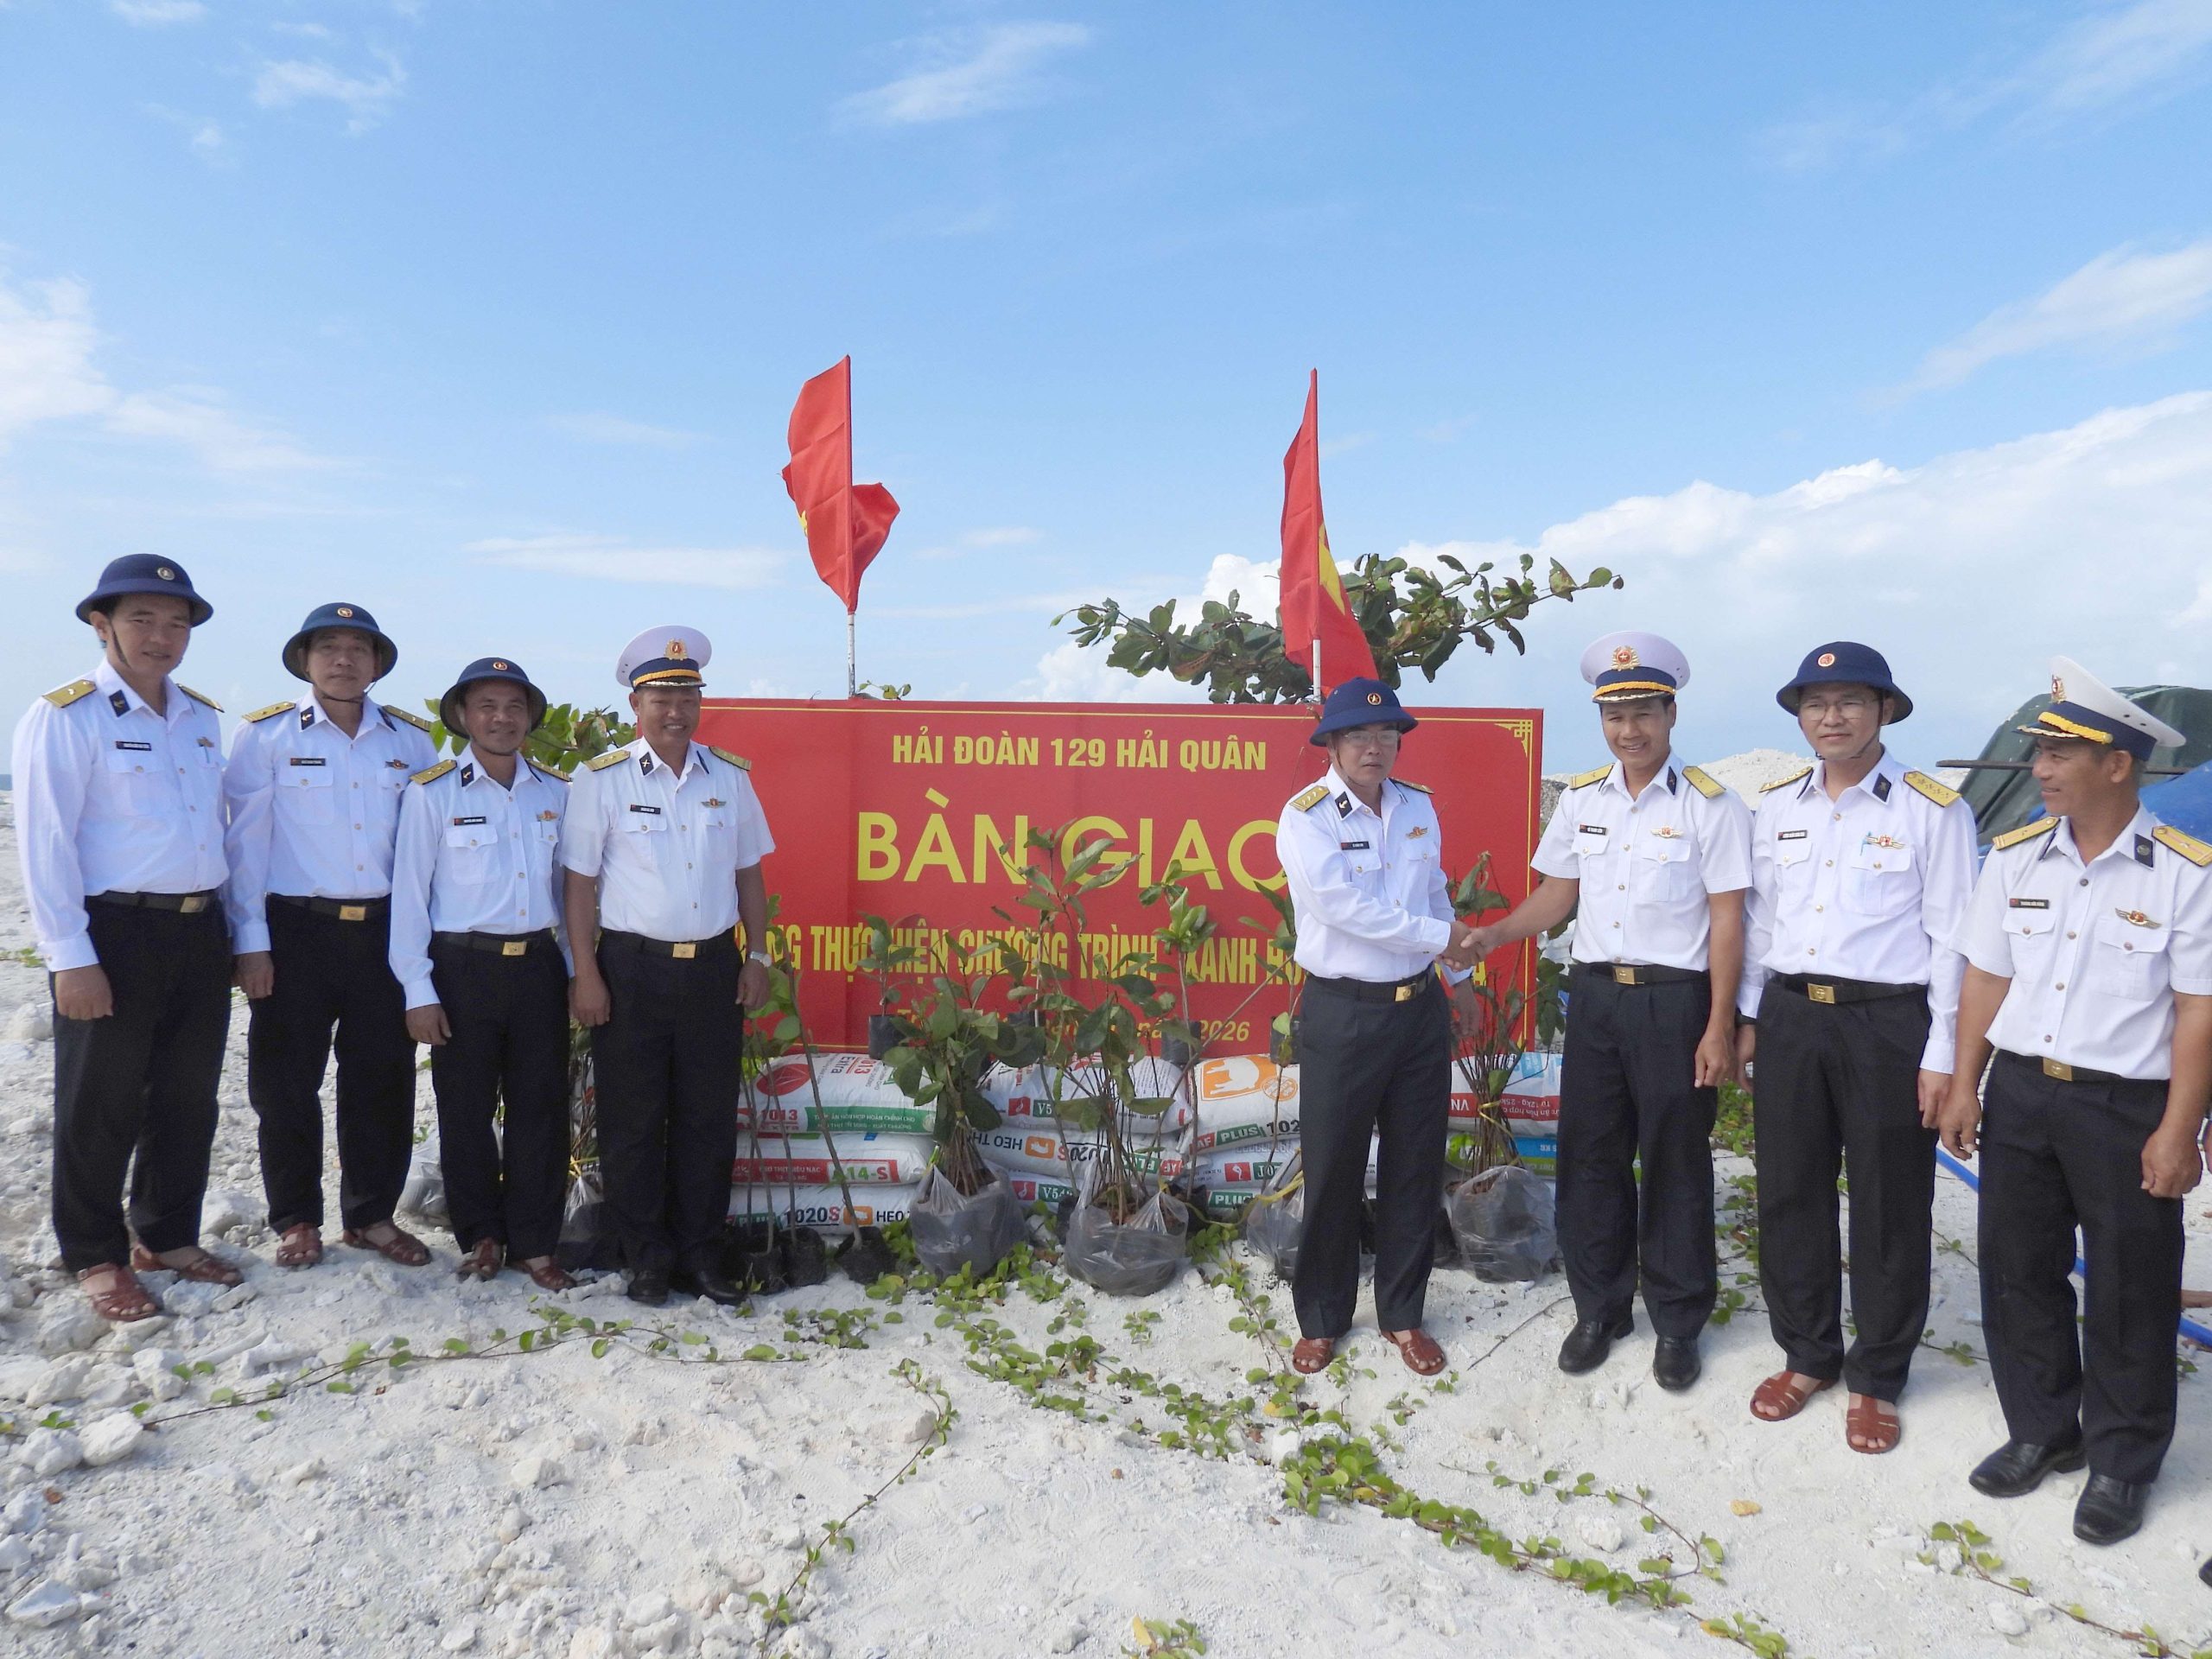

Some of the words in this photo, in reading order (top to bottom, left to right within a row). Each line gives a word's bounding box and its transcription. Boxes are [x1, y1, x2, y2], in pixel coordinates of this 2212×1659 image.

[893, 726, 944, 764] HẢI
[954, 730, 1039, 766] ĐOÀN
[1051, 738, 1106, 767] 129
[1116, 729, 1168, 769] HẢI
[1179, 734, 1267, 772] QUÂN
[857, 787, 1029, 885] BÀN
[1060, 815, 1288, 893] GIAO
[1077, 924, 1158, 982] TRÌNH
[1200, 1019, 1250, 1042] 2026
[969, 1131, 990, 1146] TH
[994, 1135, 1023, 1150] HEO
[1220, 1126, 1259, 1142] PLUS
[1215, 1193, 1251, 1205] PLU
[784, 1205, 841, 1224] 1020S
[876, 1211, 905, 1223] HEO
